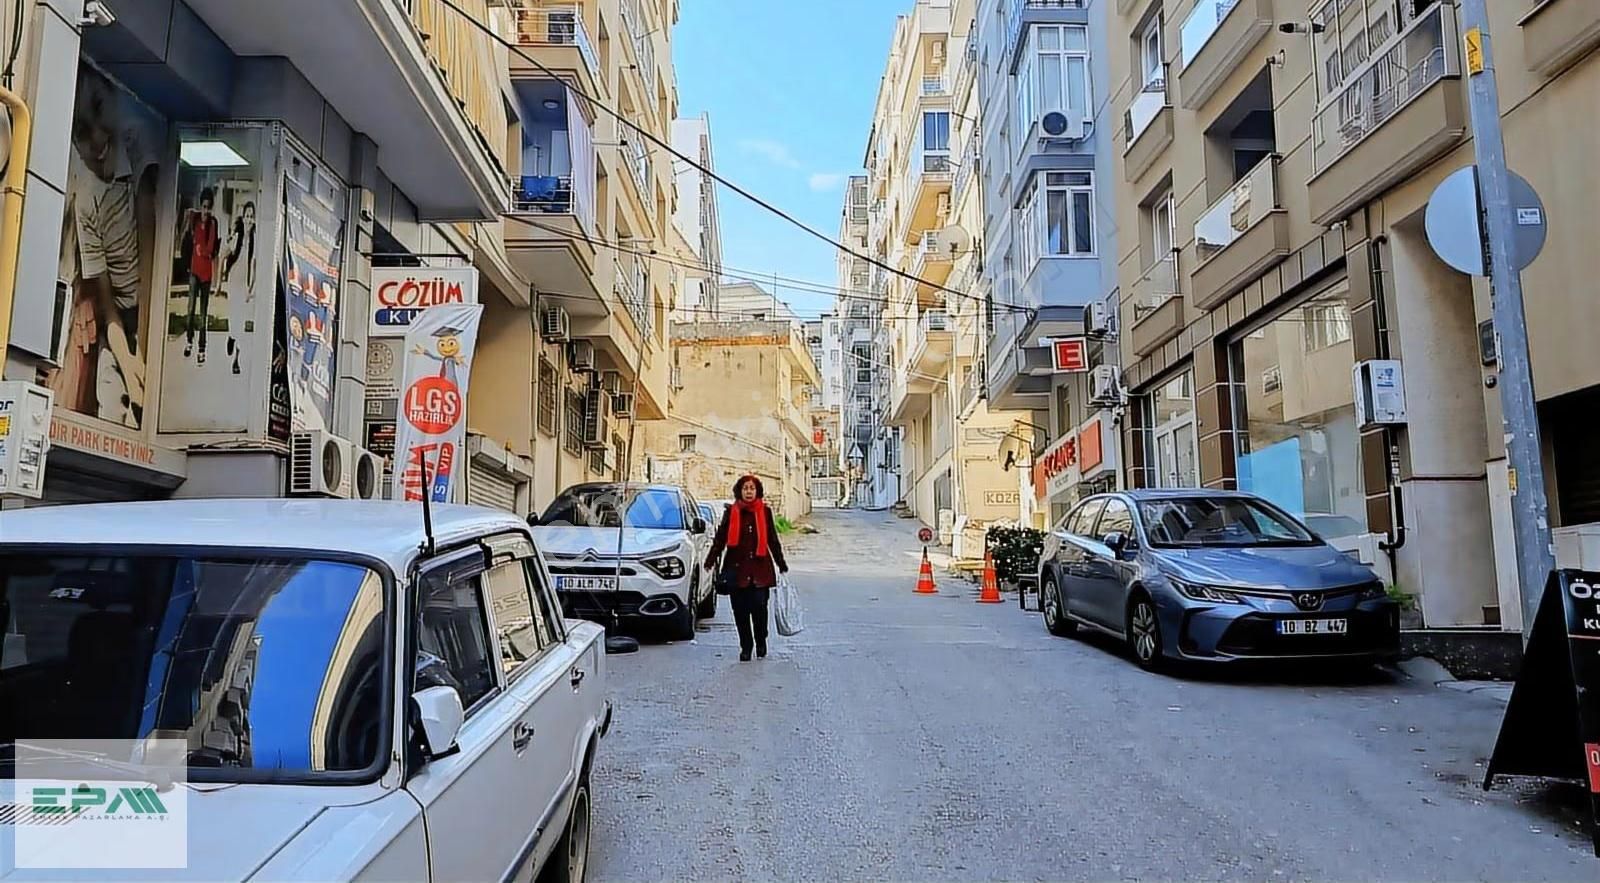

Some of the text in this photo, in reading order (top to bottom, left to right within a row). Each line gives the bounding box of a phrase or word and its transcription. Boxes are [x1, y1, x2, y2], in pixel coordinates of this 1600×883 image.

[378, 277, 463, 310] ÇÖZÜM
[1059, 343, 1082, 369] E
[410, 386, 457, 415] LGS
[409, 409, 454, 425] HAZIRLIK
[71, 426, 100, 449] PARK
[563, 578, 574, 588] 10
[1283, 619, 1346, 633] 10 BZ 447
